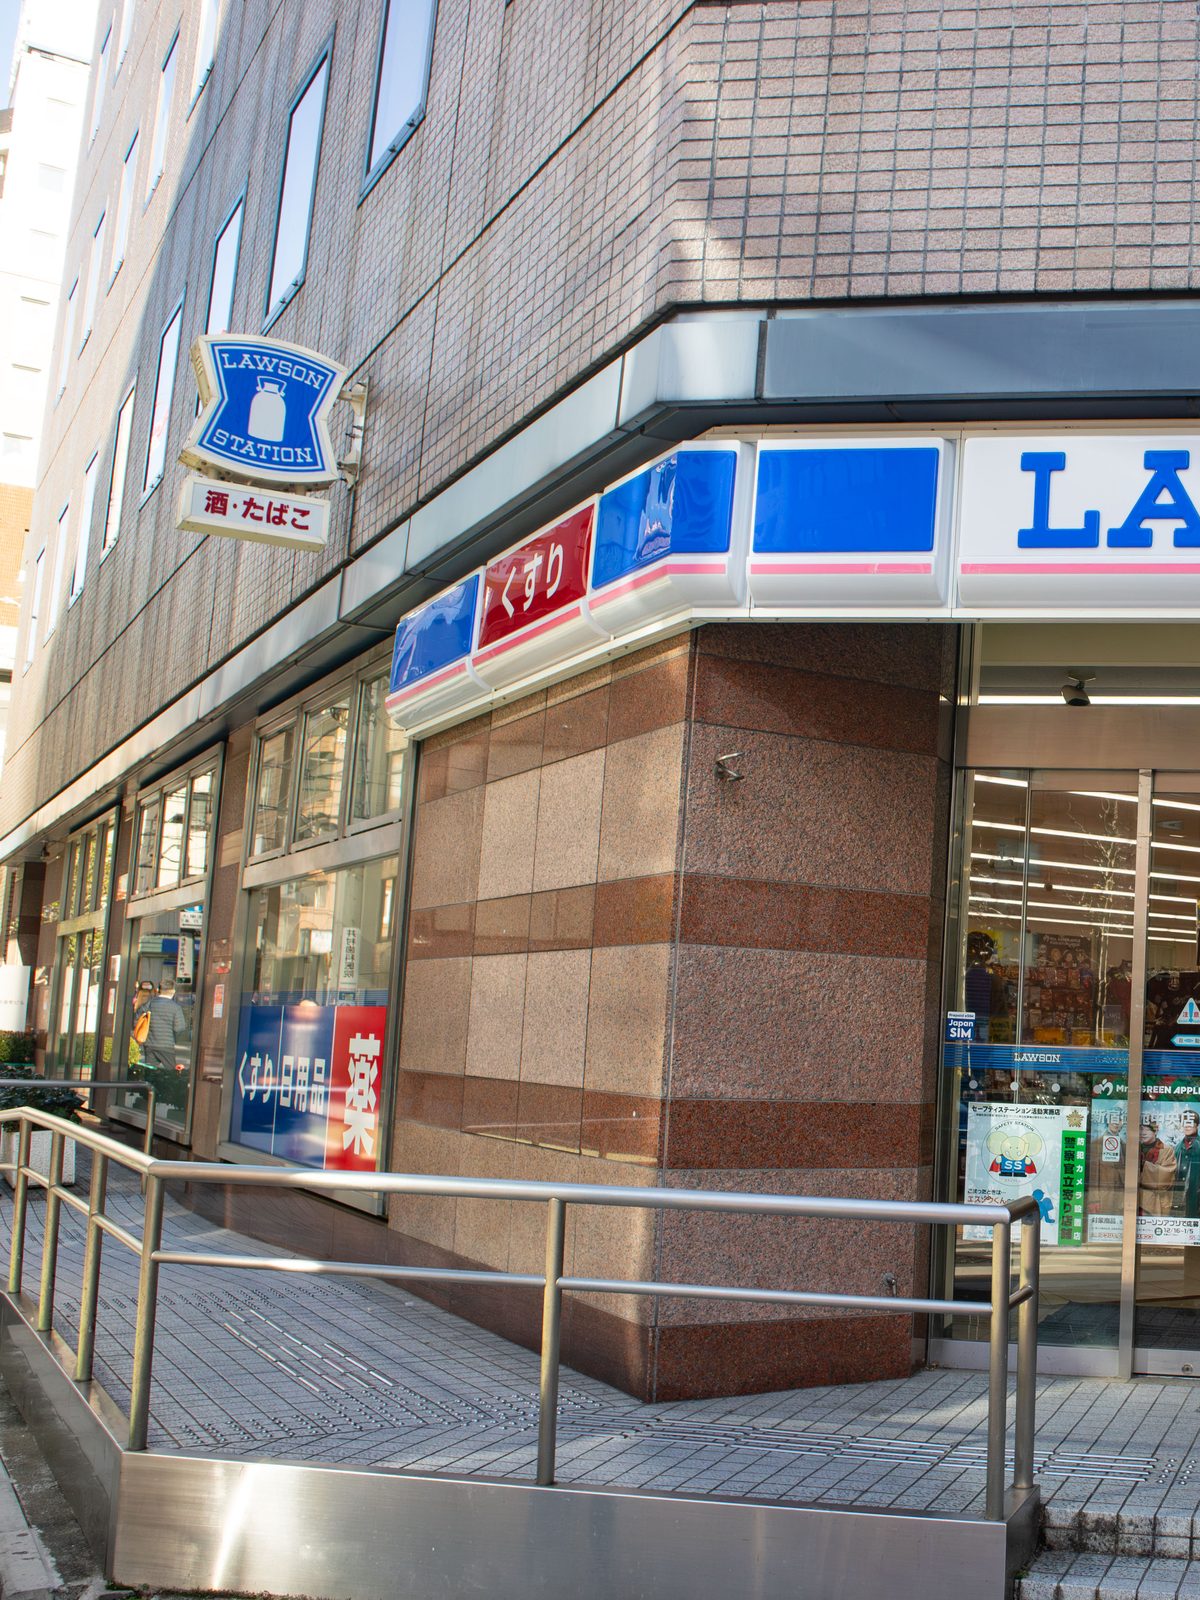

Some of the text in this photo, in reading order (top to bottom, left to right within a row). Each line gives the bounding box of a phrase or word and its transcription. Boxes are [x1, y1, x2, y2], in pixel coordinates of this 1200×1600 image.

[221, 353, 324, 390] LAWSON
[212, 428, 313, 463] STATION
[204, 489, 311, 531] 酒・たばこ
[501, 542, 564, 618] くすり
[948, 1019, 974, 1029] Japan
[949, 1028, 972, 1038] SIM
[1014, 1052, 1060, 1063] LAWSON
[238, 1051, 326, 1116] くすり 日用品
[342, 1032, 381, 1156] 薬
[1004, 1160, 1022, 1169] SS
